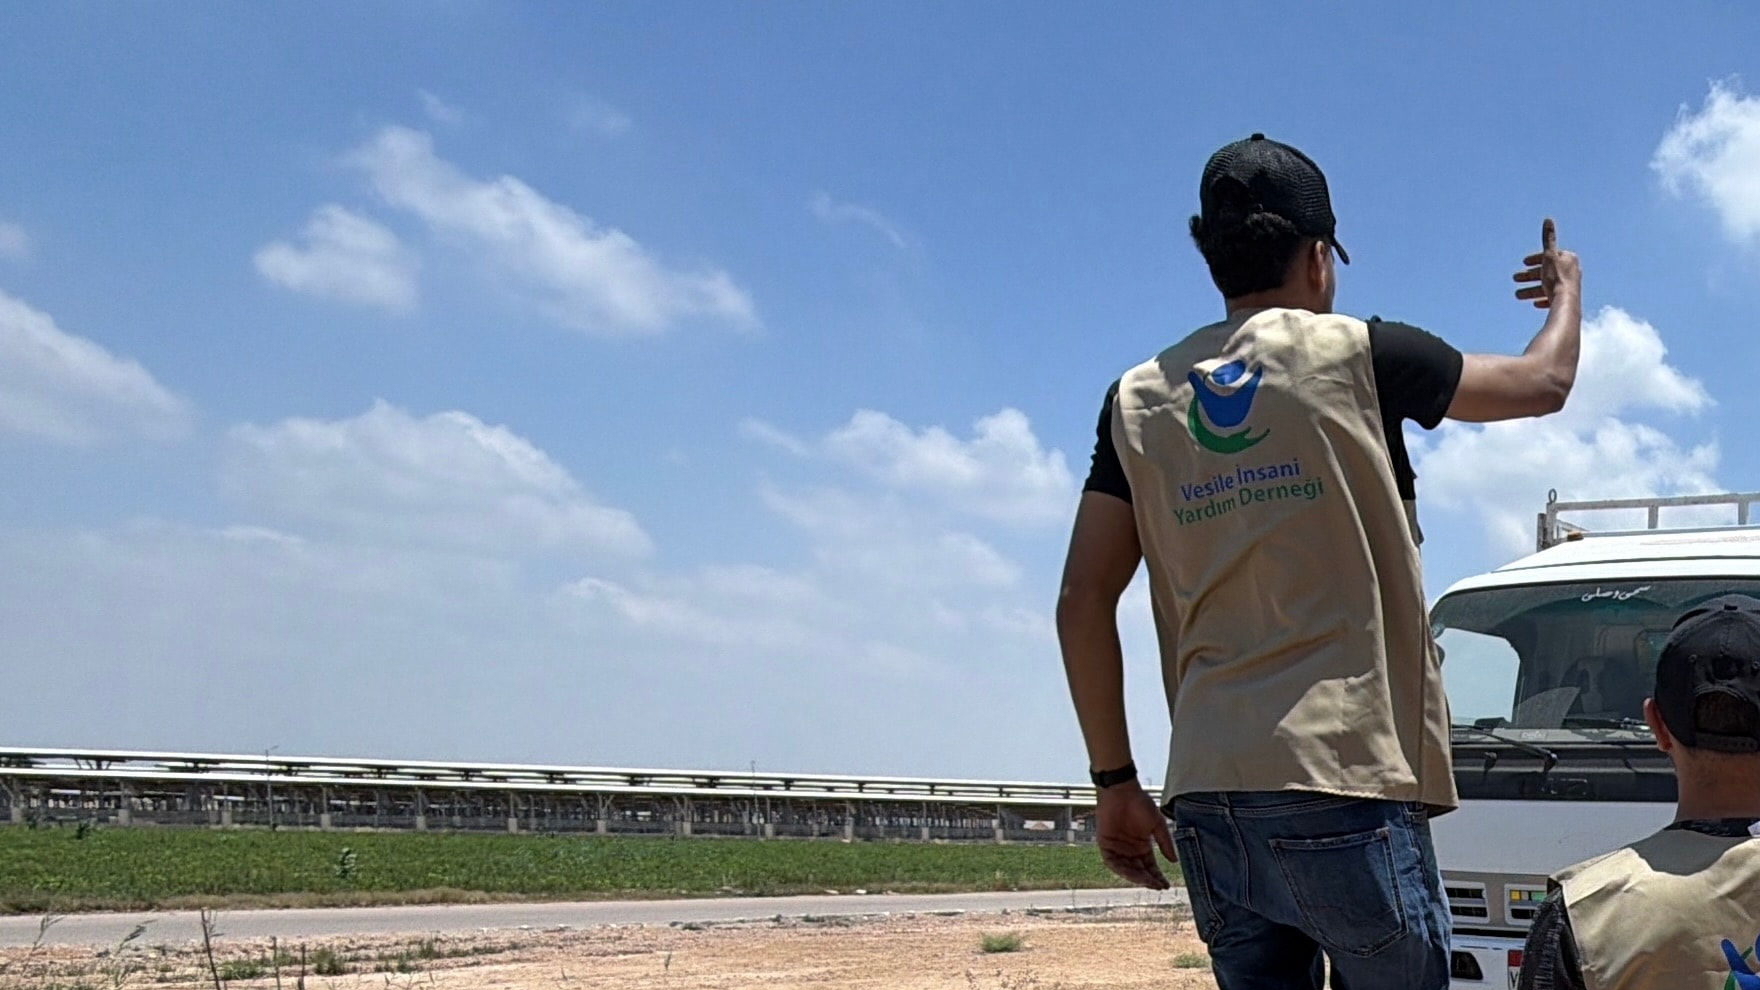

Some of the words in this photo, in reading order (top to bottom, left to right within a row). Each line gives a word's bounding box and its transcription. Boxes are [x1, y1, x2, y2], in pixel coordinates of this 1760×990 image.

[1173, 498, 1236, 526] Yardım
[1238, 477, 1324, 506] Derneği
[1181, 474, 1234, 501] Vesile
[1236, 458, 1300, 485] İnsani
